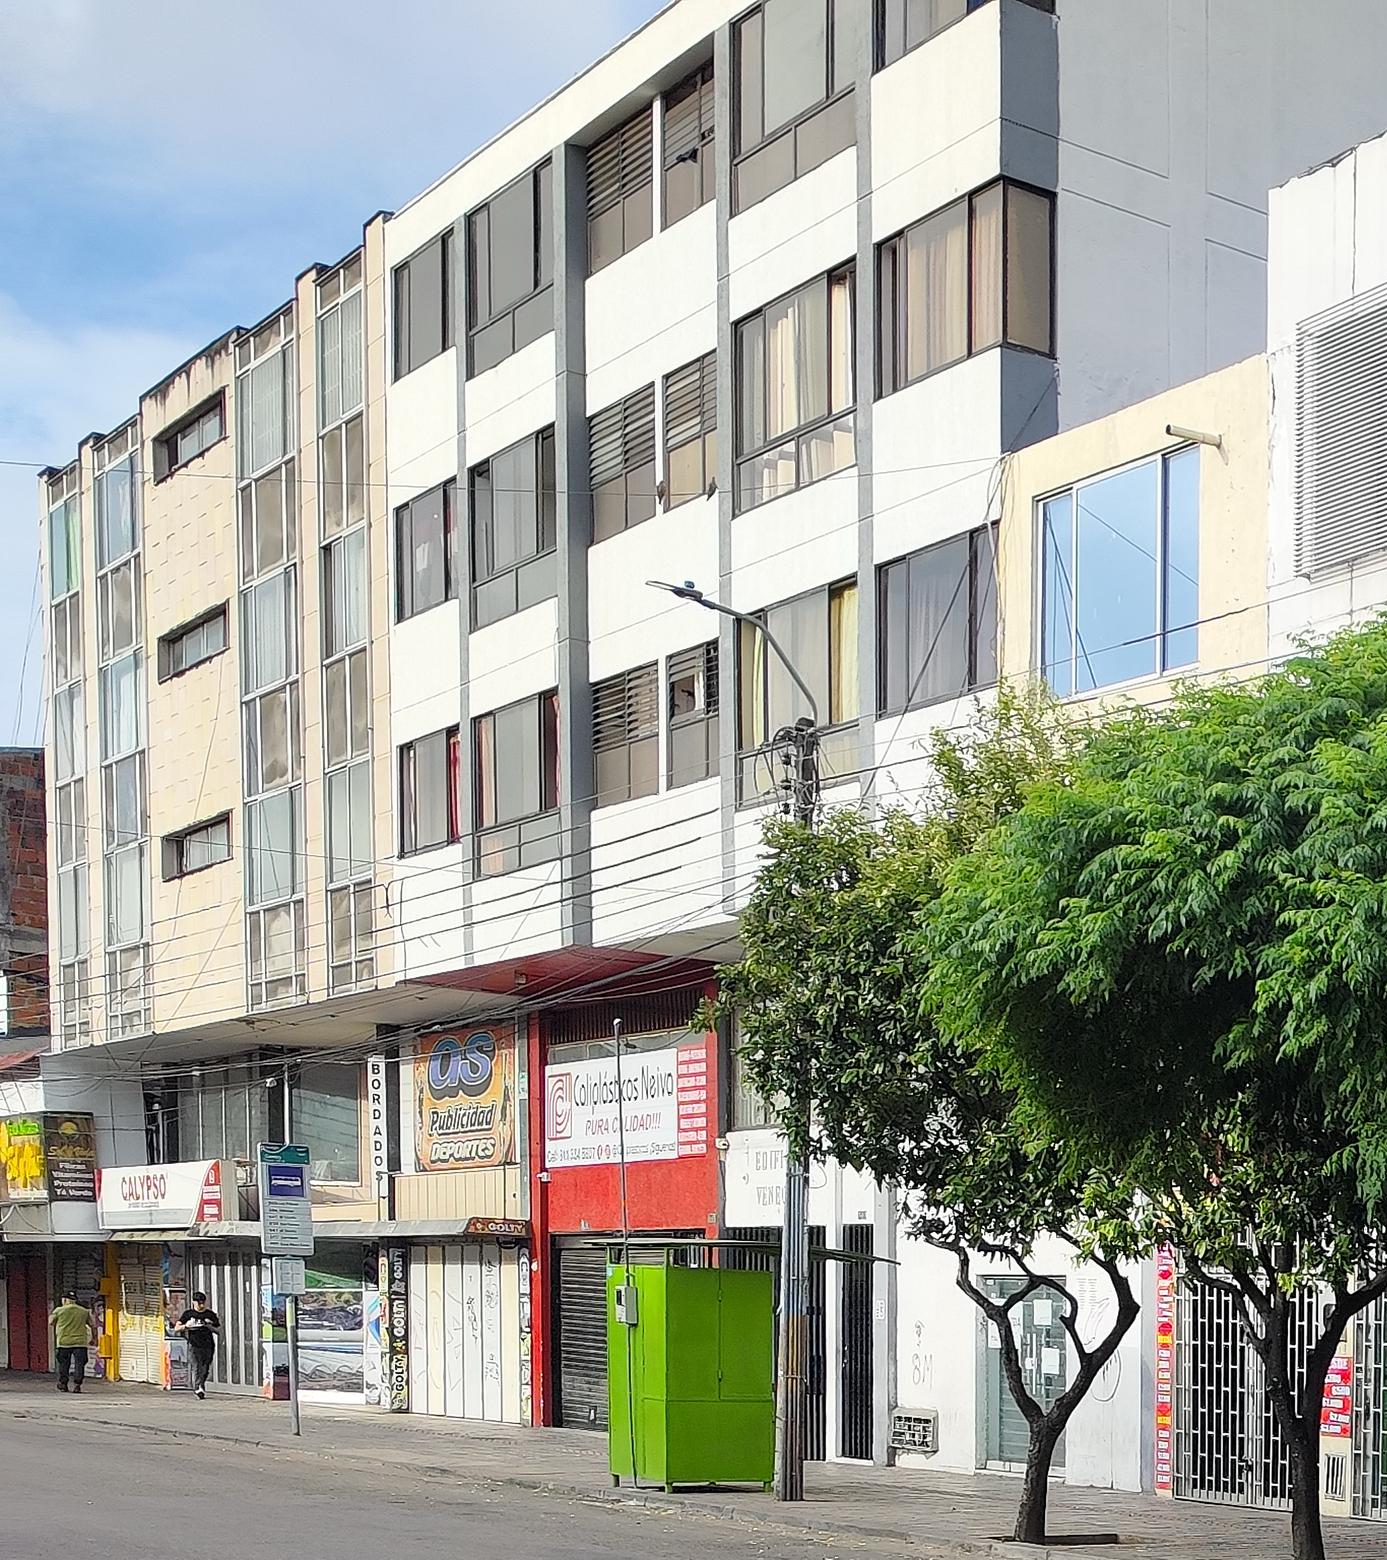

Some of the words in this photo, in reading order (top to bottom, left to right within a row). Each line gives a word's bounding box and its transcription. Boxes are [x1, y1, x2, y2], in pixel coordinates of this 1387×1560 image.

[371, 1063, 383, 1181] BORDADOS
[428, 1101, 496, 1136] Publicidad
[585, 1117, 609, 1137] PURA
[612, 1112, 662, 1133] CLIDAD!!!
[429, 1138, 496, 1163] DEPORTES
[755, 1149, 784, 1171] EDIFI
[121, 1173, 167, 1201] CALYPSO
